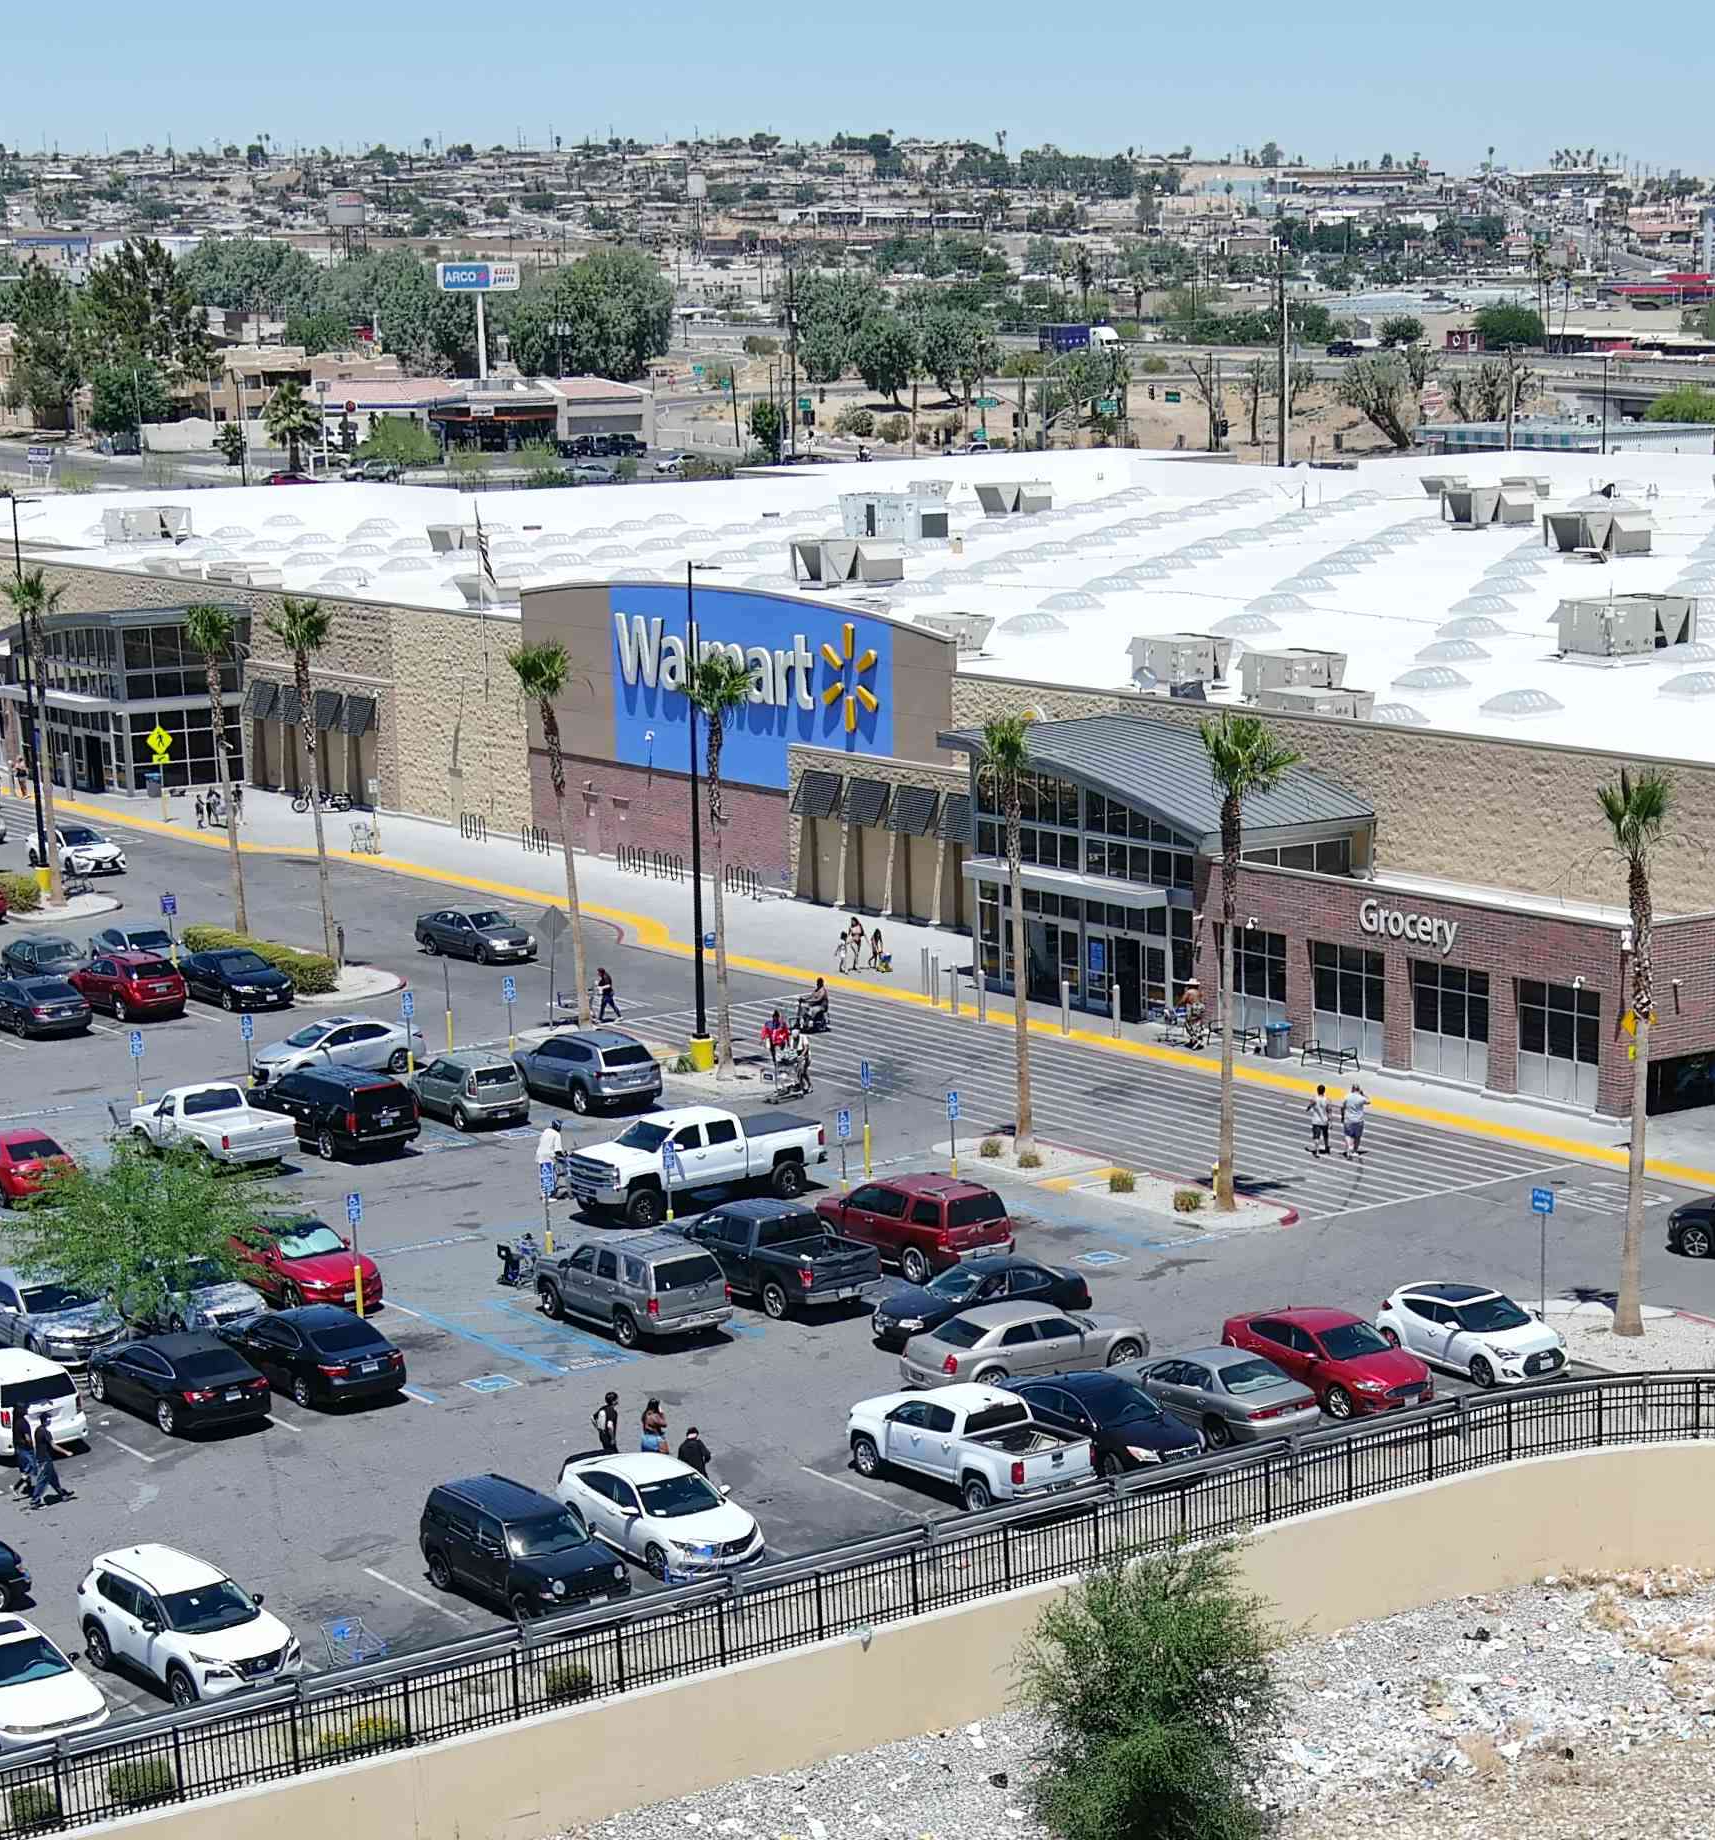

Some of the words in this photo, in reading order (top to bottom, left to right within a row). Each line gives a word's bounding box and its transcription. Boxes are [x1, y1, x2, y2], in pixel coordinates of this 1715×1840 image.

[445, 269, 477, 283] ARCO
[614, 612, 815, 711] Walmart
[1359, 898, 1459, 955] Grocery
